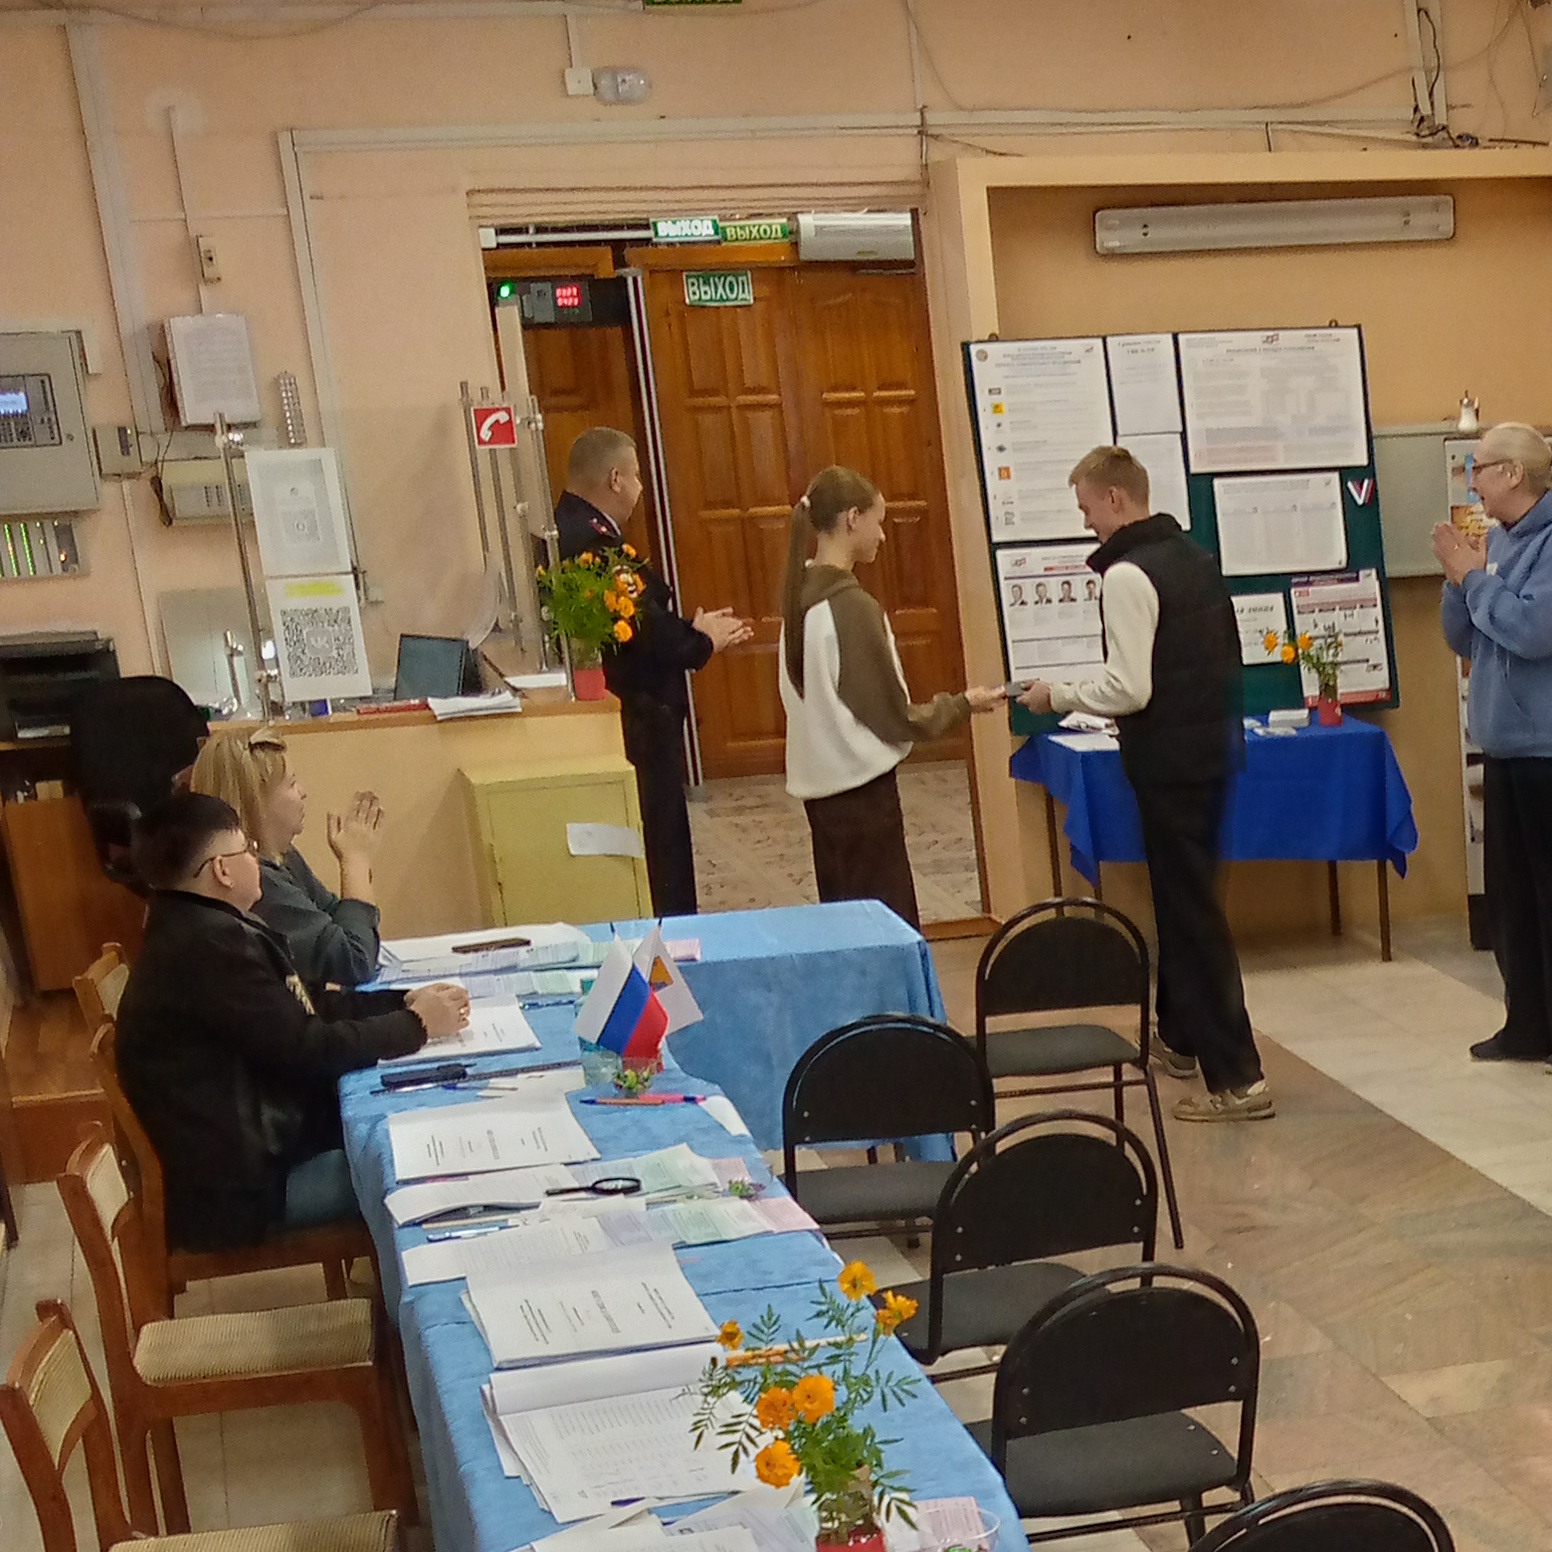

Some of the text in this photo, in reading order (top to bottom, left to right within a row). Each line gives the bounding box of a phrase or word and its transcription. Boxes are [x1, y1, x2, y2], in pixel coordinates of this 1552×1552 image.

[657, 219, 714, 237] ВЫХОД
[726, 223, 782, 240] ВЫХОД
[688, 276, 751, 301] ВЫХОД
